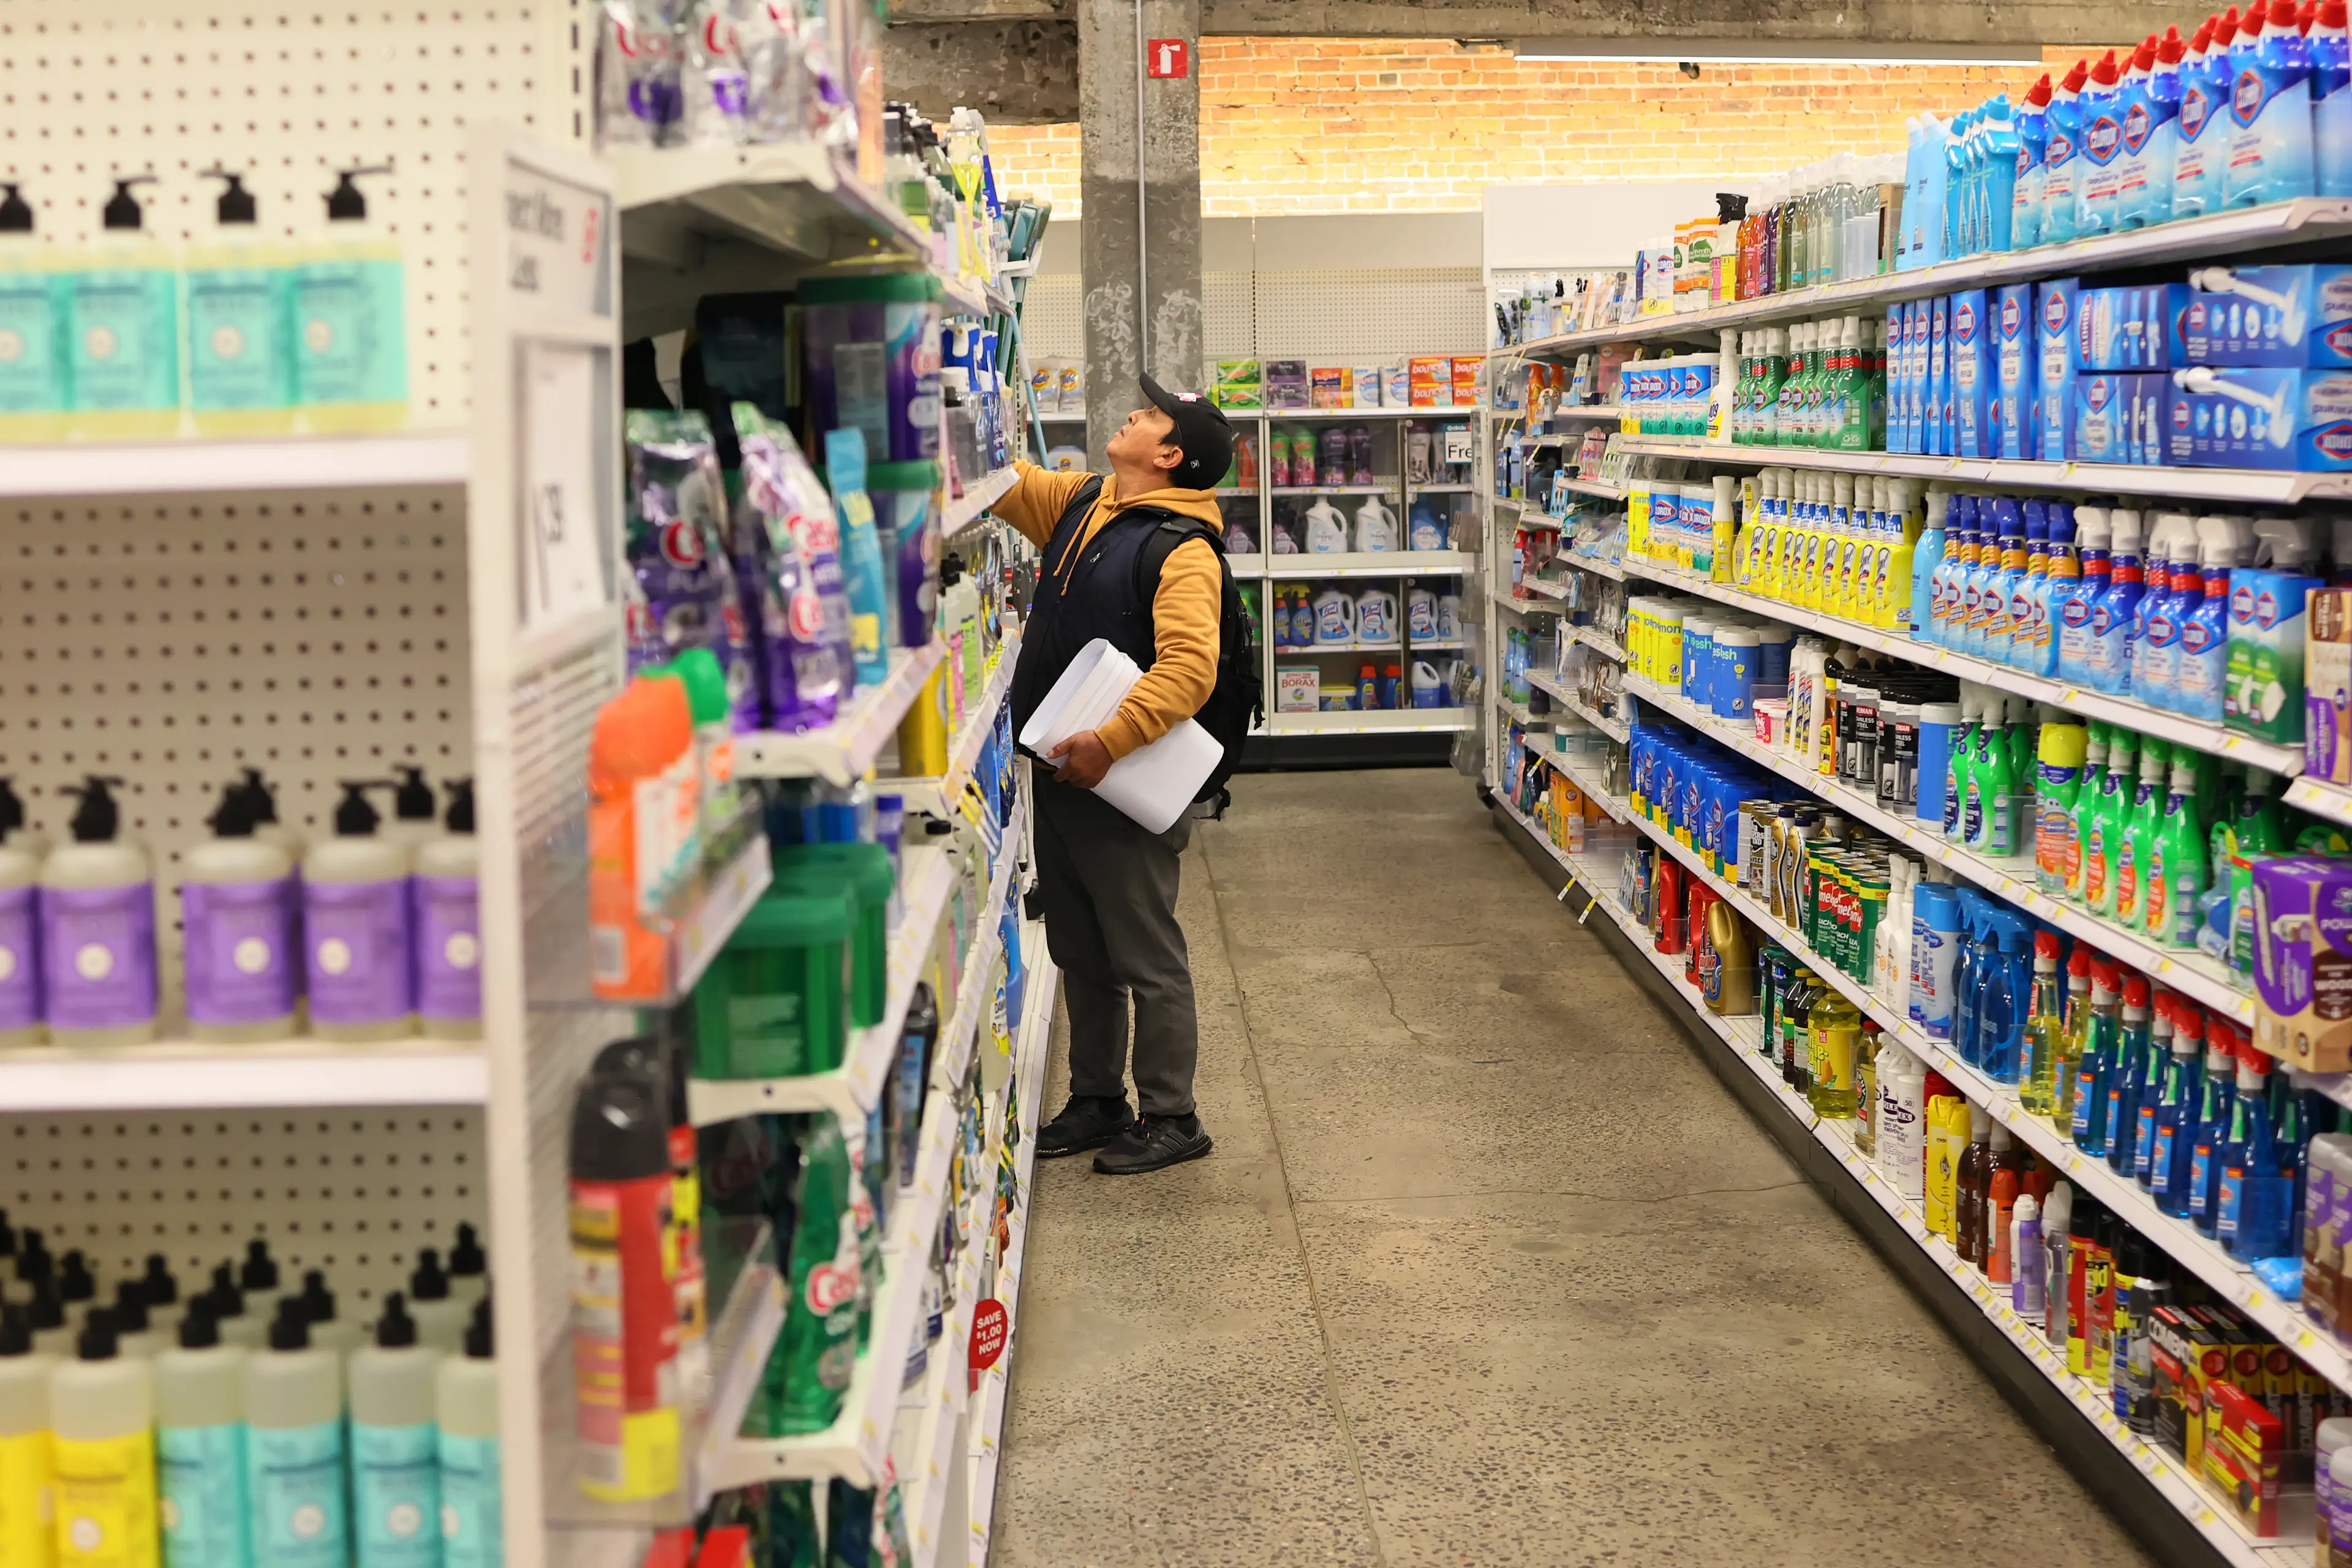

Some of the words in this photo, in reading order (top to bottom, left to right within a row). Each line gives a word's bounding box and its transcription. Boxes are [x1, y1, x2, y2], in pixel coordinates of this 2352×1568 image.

[1659, 625, 1681, 634] mon
[1695, 638, 1713, 650] esh
[1281, 678, 1316, 688] BORAX
[1884, 1102, 1898, 1111] OLE
[977, 1310, 1001, 1329] SAVE
[976, 1323, 1003, 1341] $1.00
[978, 1337, 1001, 1355] NOW
